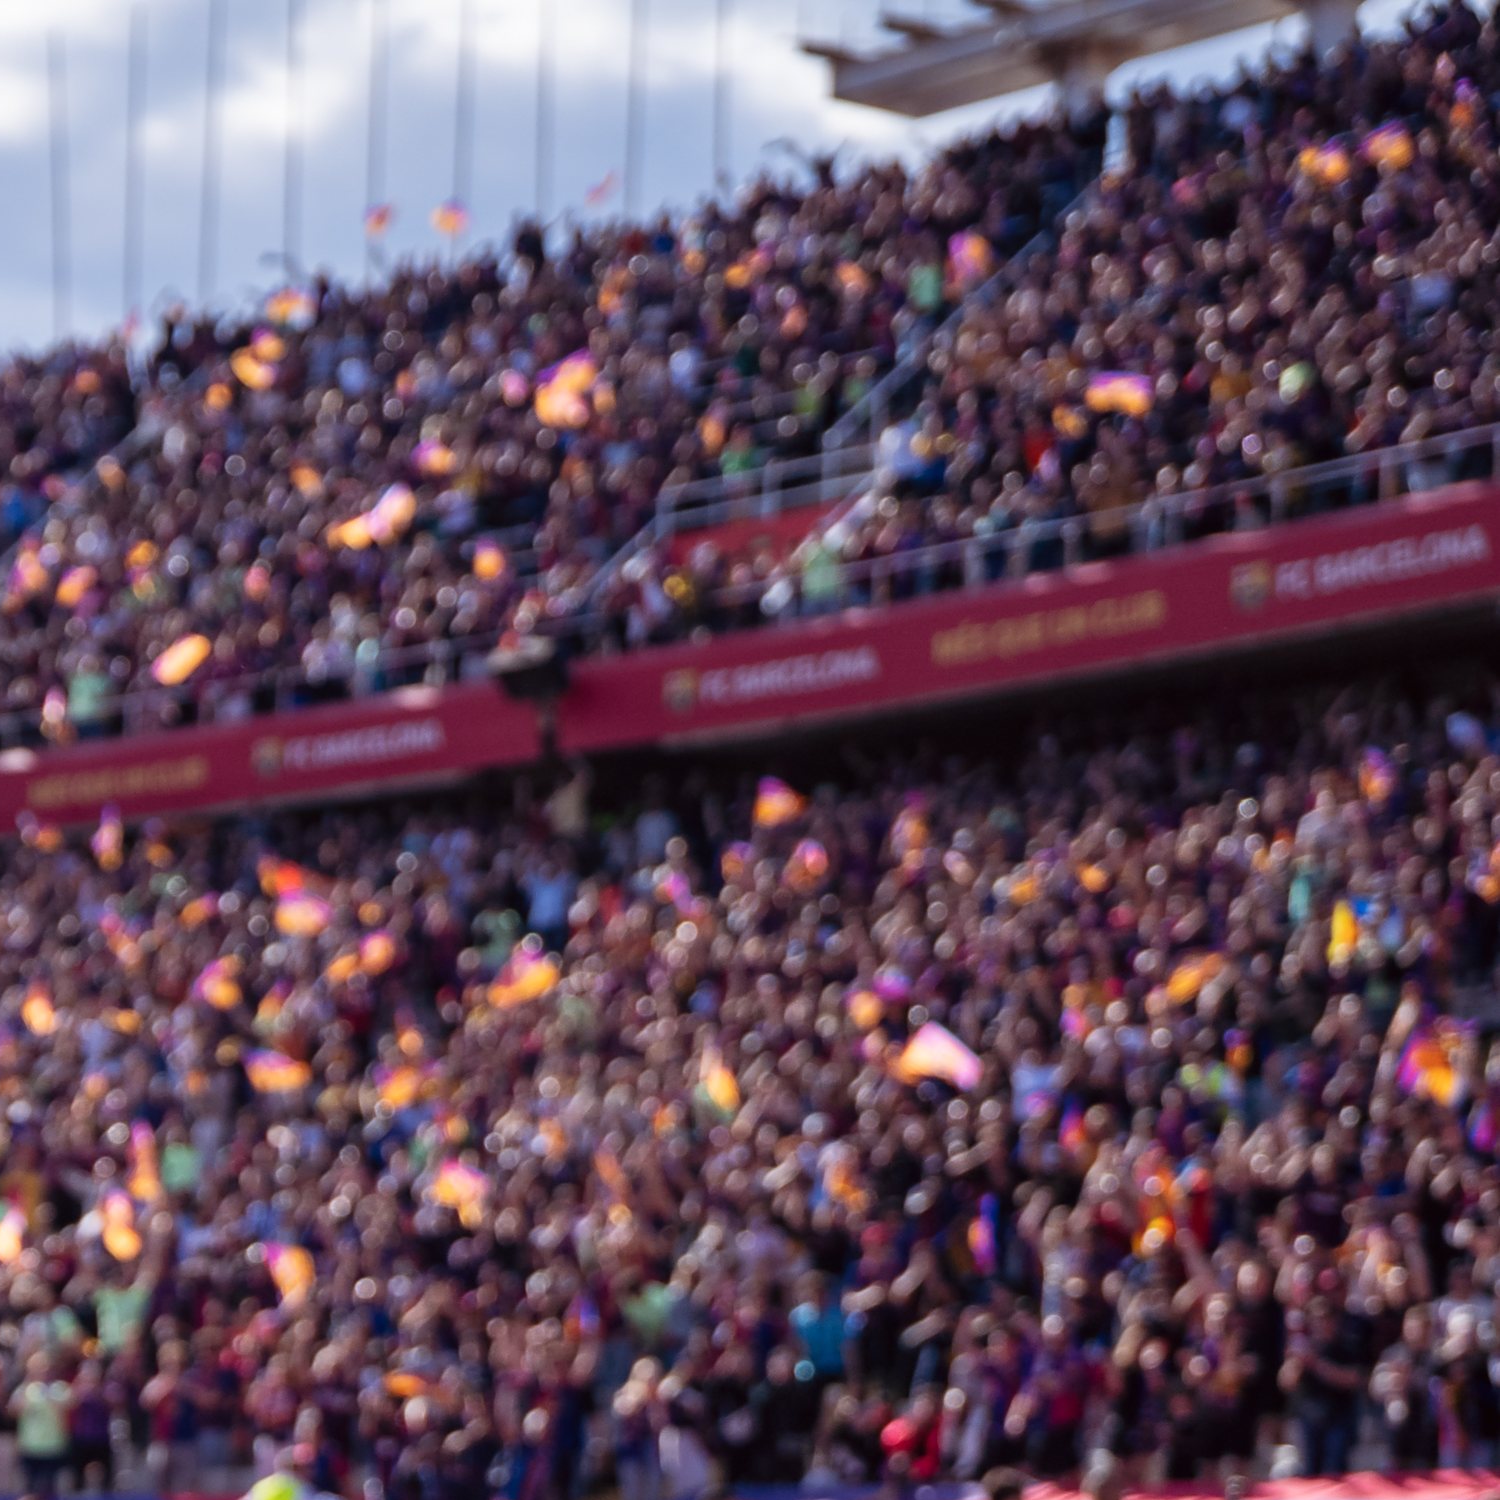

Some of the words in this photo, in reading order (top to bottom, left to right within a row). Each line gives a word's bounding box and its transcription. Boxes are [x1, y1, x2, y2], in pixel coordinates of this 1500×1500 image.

[1275, 558, 1313, 600] FC
[1314, 523, 1490, 593] BARCELONA
[733, 644, 882, 698] BARCELONA
[313, 719, 446, 768] BARCELONA
